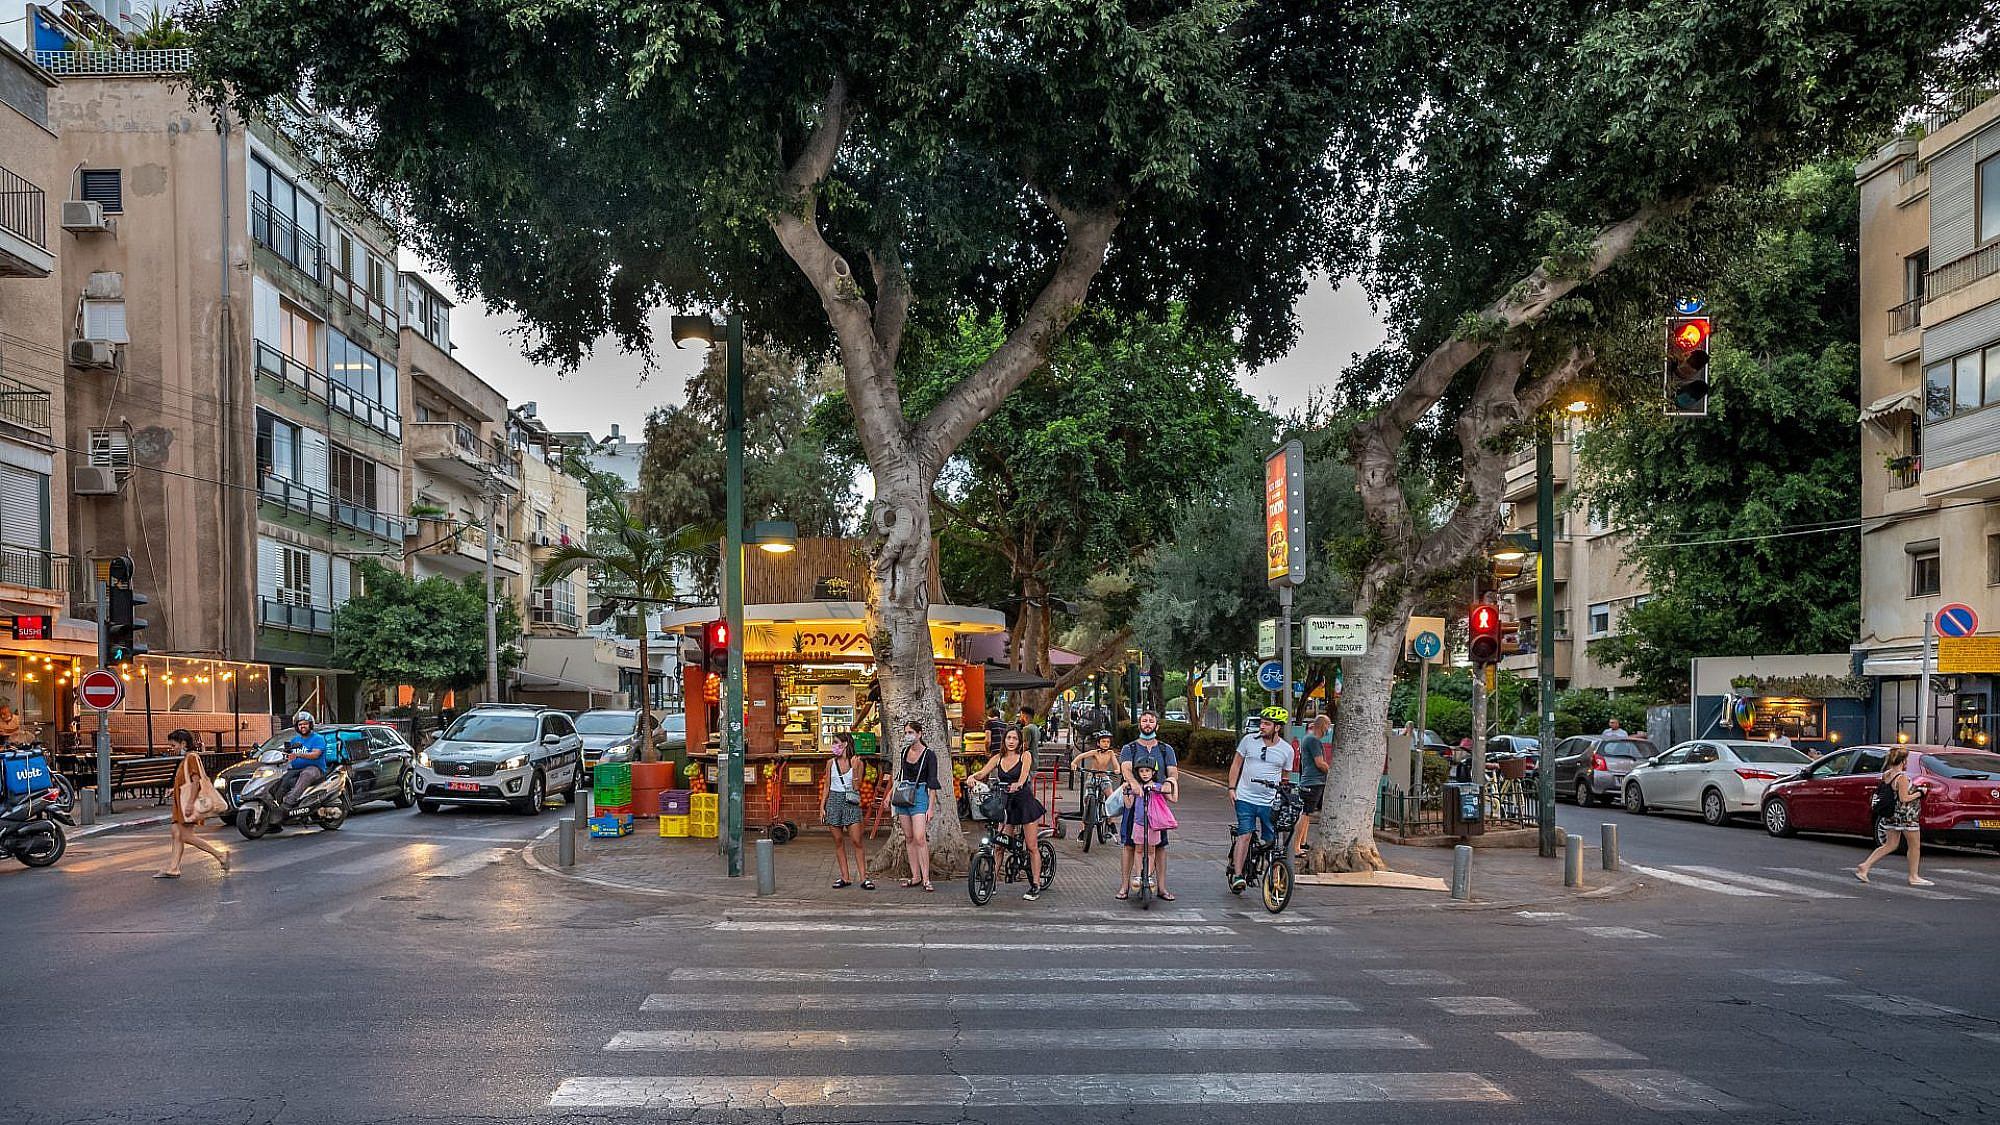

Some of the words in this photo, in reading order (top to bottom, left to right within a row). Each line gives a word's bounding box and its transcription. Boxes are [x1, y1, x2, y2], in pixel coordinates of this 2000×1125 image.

[18, 627, 42, 636] SUSHI
[803, 632, 872, 652] תמרה
[16, 767, 43, 780] Wolt
